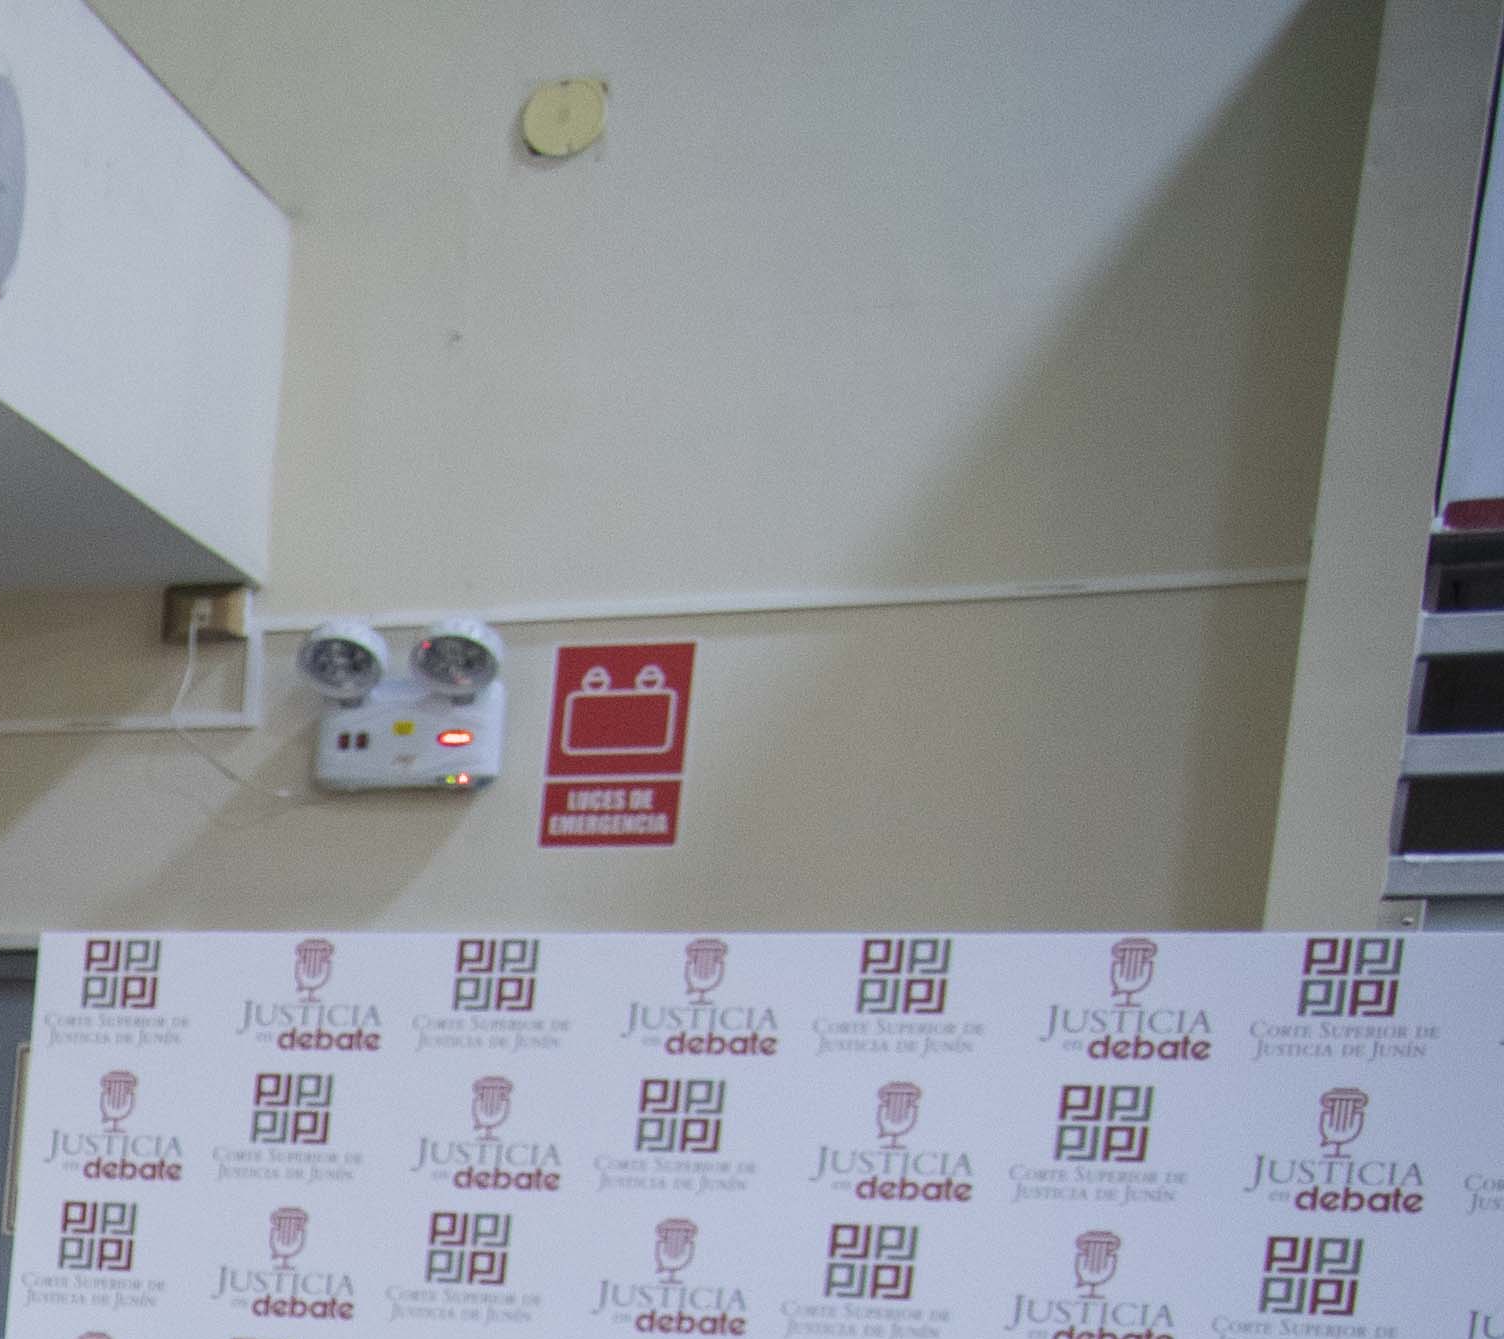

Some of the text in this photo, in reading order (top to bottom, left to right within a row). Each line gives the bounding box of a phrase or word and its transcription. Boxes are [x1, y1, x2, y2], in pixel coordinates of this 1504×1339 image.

[566, 787, 655, 812] LUCES DE
[548, 813, 670, 836] EMERGENCIA
[235, 999, 382, 1035] JUSTICIA
[619, 1002, 778, 1040] JUSTICIA
[1038, 1005, 1212, 1044] JUSTICIA
[276, 1025, 381, 1051] debate
[664, 1029, 778, 1057] debate
[1087, 1033, 1211, 1062] debate
[43, 1129, 183, 1164] JUSTICIA
[410, 1136, 562, 1173] JUSTICIA
[83, 1155, 183, 1181] debate
[453, 1164, 561, 1191] debate
[808, 1145, 974, 1183] JUSTICIA
[1244, 1154, 1425, 1193] JUSTICIA
[855, 1173, 973, 1202] debate
[1295, 1184, 1424, 1214] debate
[210, 1265, 355, 1300] JUSTICIA
[590, 1278, 747, 1315] JUSTICIA
[251, 1292, 355, 1320] debate
[1003, 1293, 1175, 1332] JUSTICIA
[634, 1307, 747, 1336] debate
